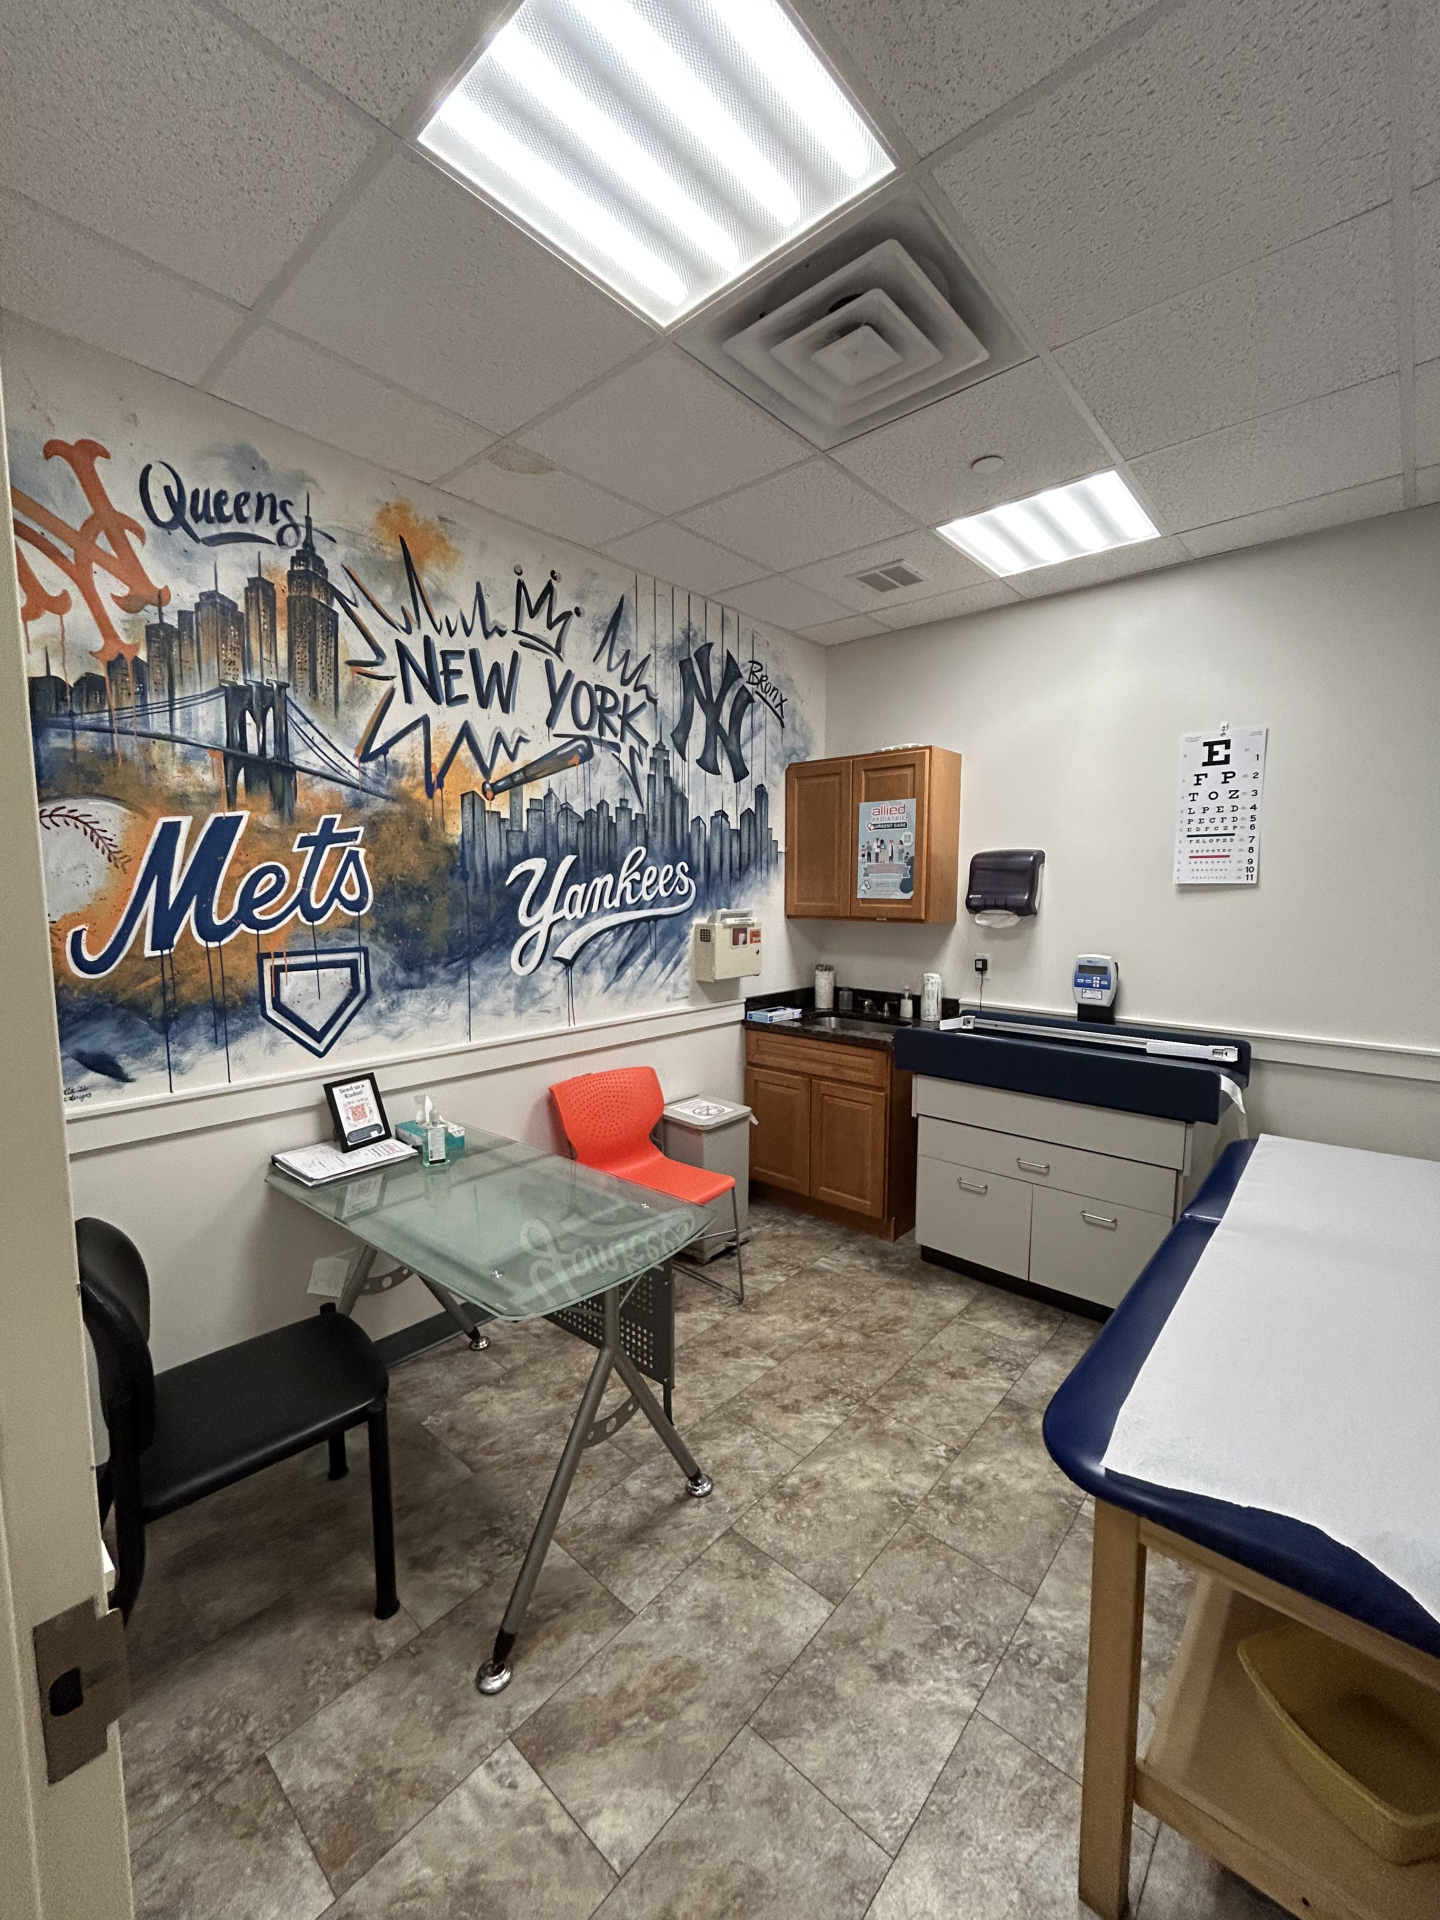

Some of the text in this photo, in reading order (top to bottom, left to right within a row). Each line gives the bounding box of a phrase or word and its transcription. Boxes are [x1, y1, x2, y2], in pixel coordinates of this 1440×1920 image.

[139, 460, 337, 549] Queens
[395, 634, 651, 750] NEW YORK
[671, 642, 756, 783] NY
[1193, 773, 1208, 786] F
[1221, 771, 1236, 784] P
[1202, 739, 1231, 767] E
[1255, 753, 1260, 761] 1
[872, 804, 906, 816] allied
[1251, 789, 1258, 797] 3
[66, 810, 374, 979] Mets
[505, 846, 696, 976] Yankees
